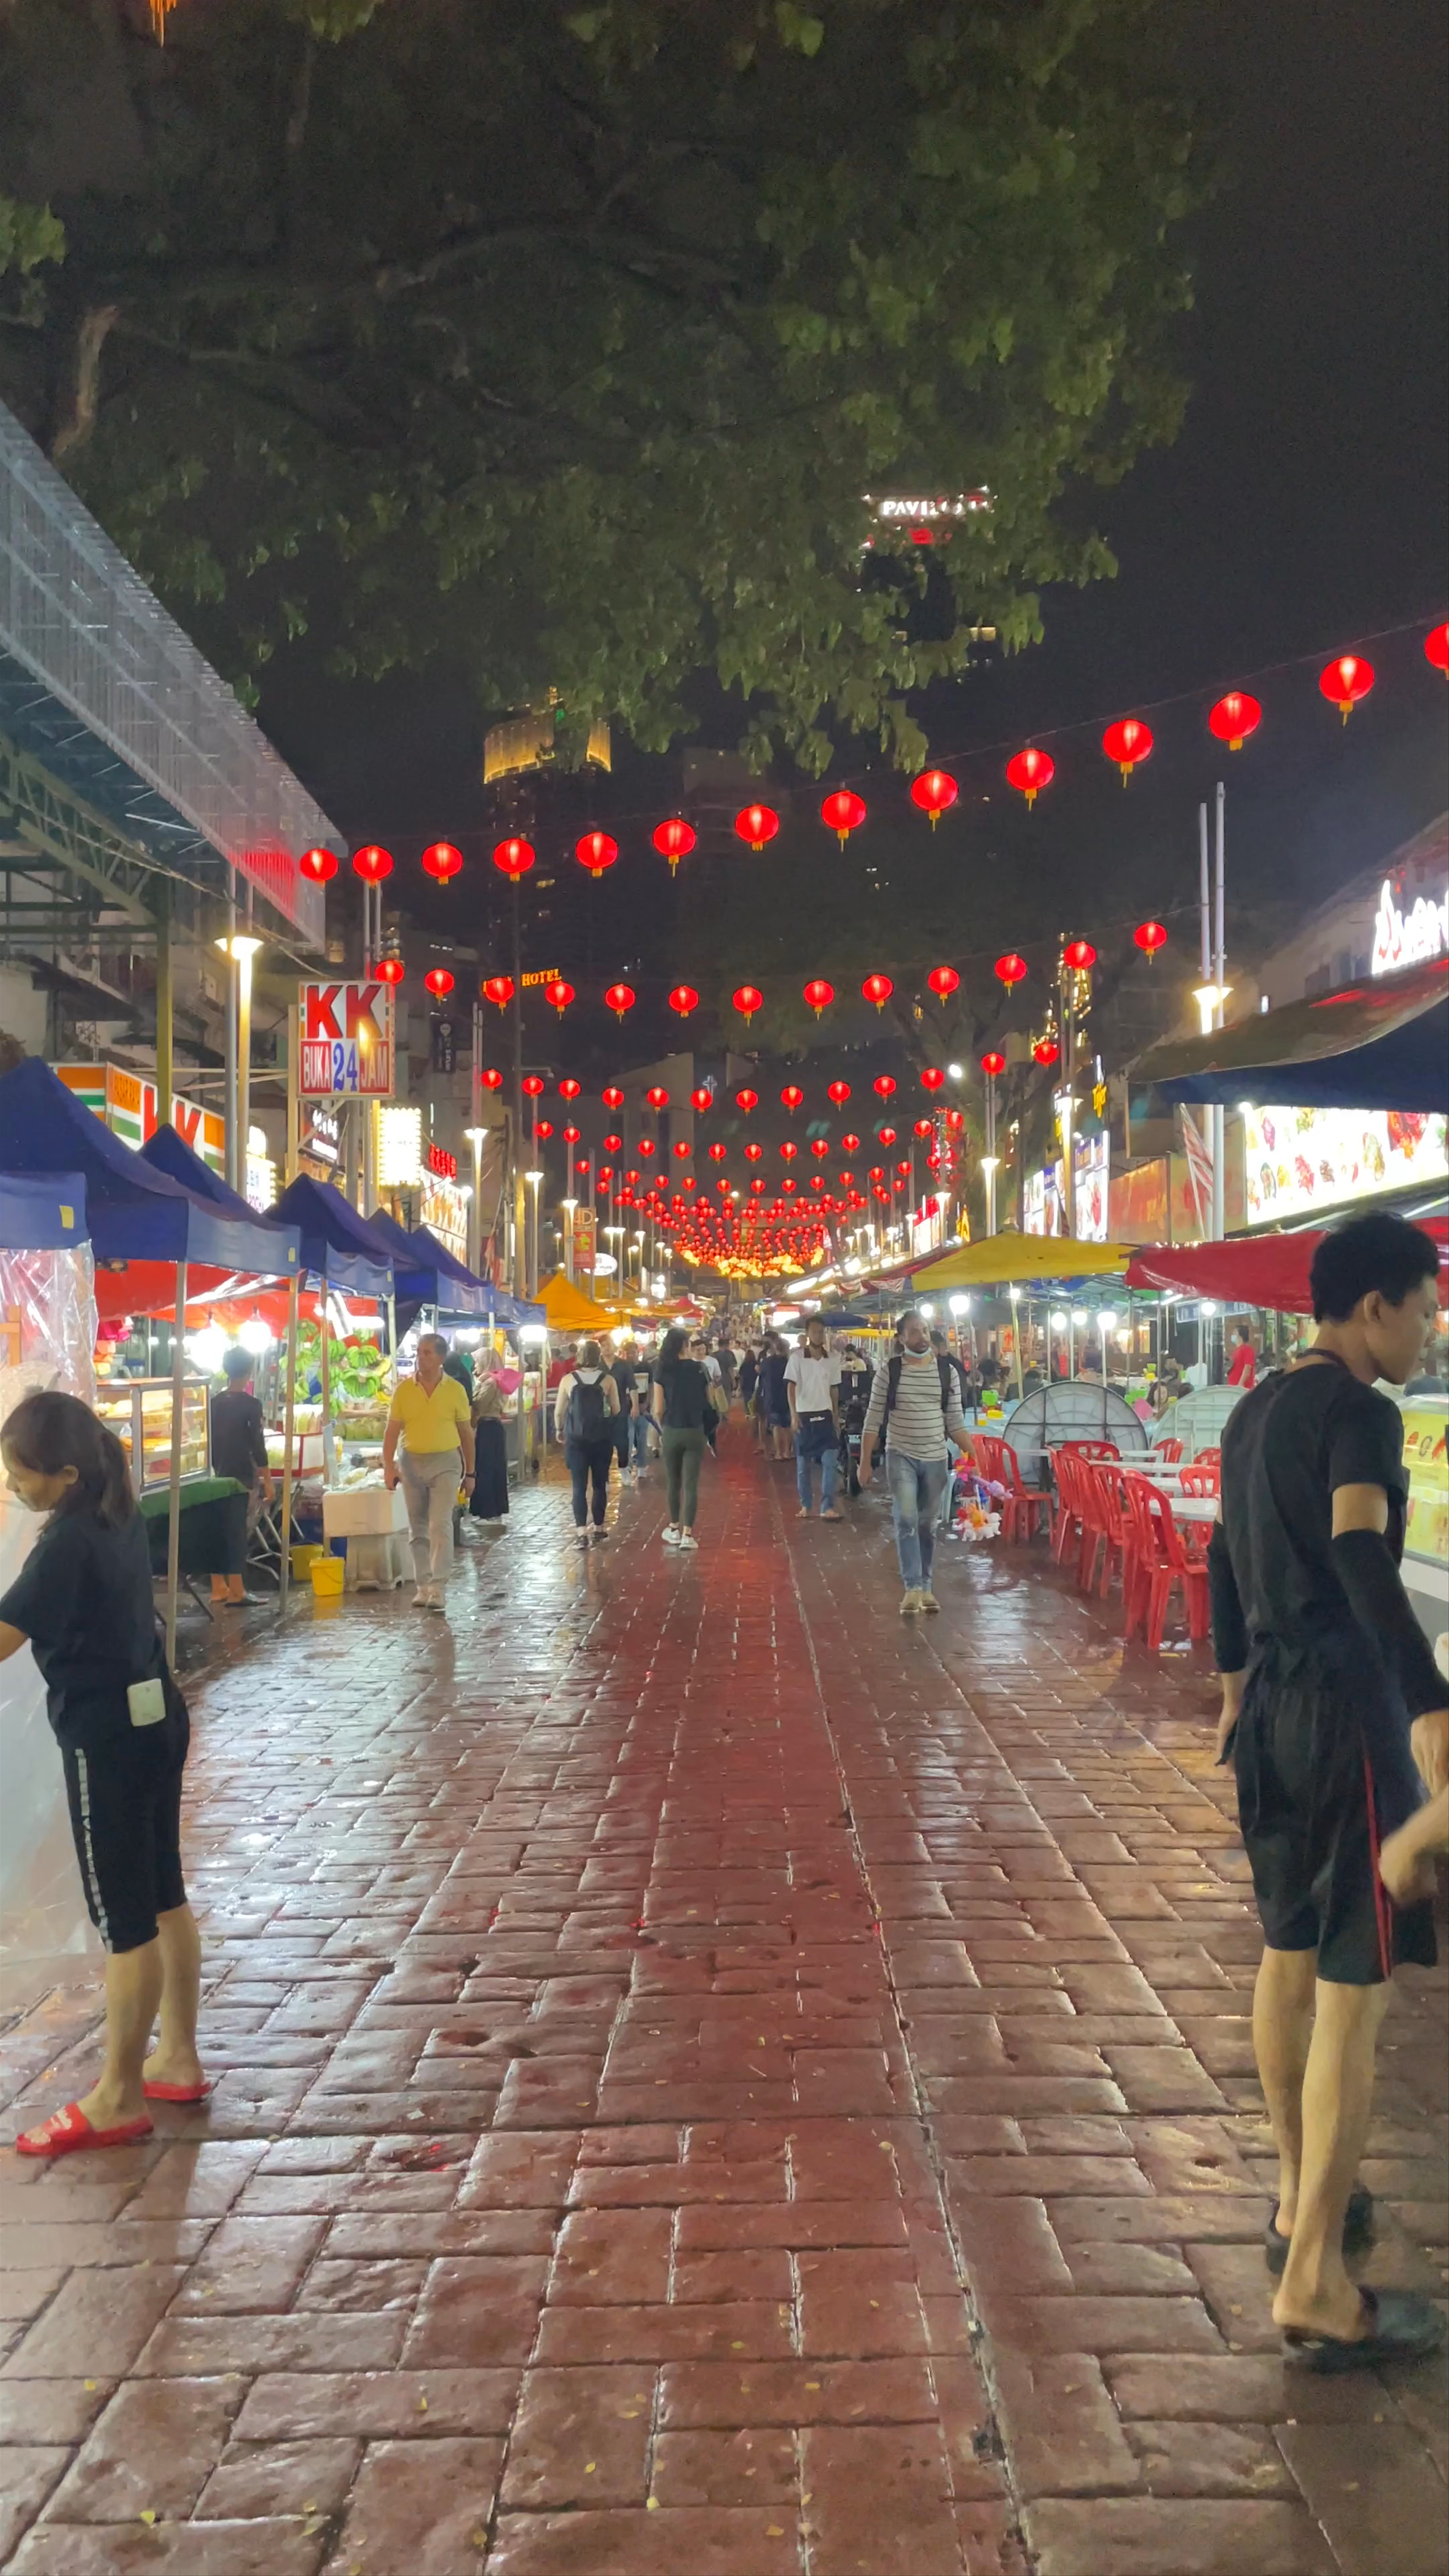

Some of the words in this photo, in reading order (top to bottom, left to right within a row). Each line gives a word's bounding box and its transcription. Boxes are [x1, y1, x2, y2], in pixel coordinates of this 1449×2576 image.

[521, 968, 562, 987] HOTEL
[306, 985, 383, 1039] KK
[303, 1045, 331, 1089] BUKA
[333, 1043, 358, 1092] 24
[360, 1044, 387, 1088] JAM
